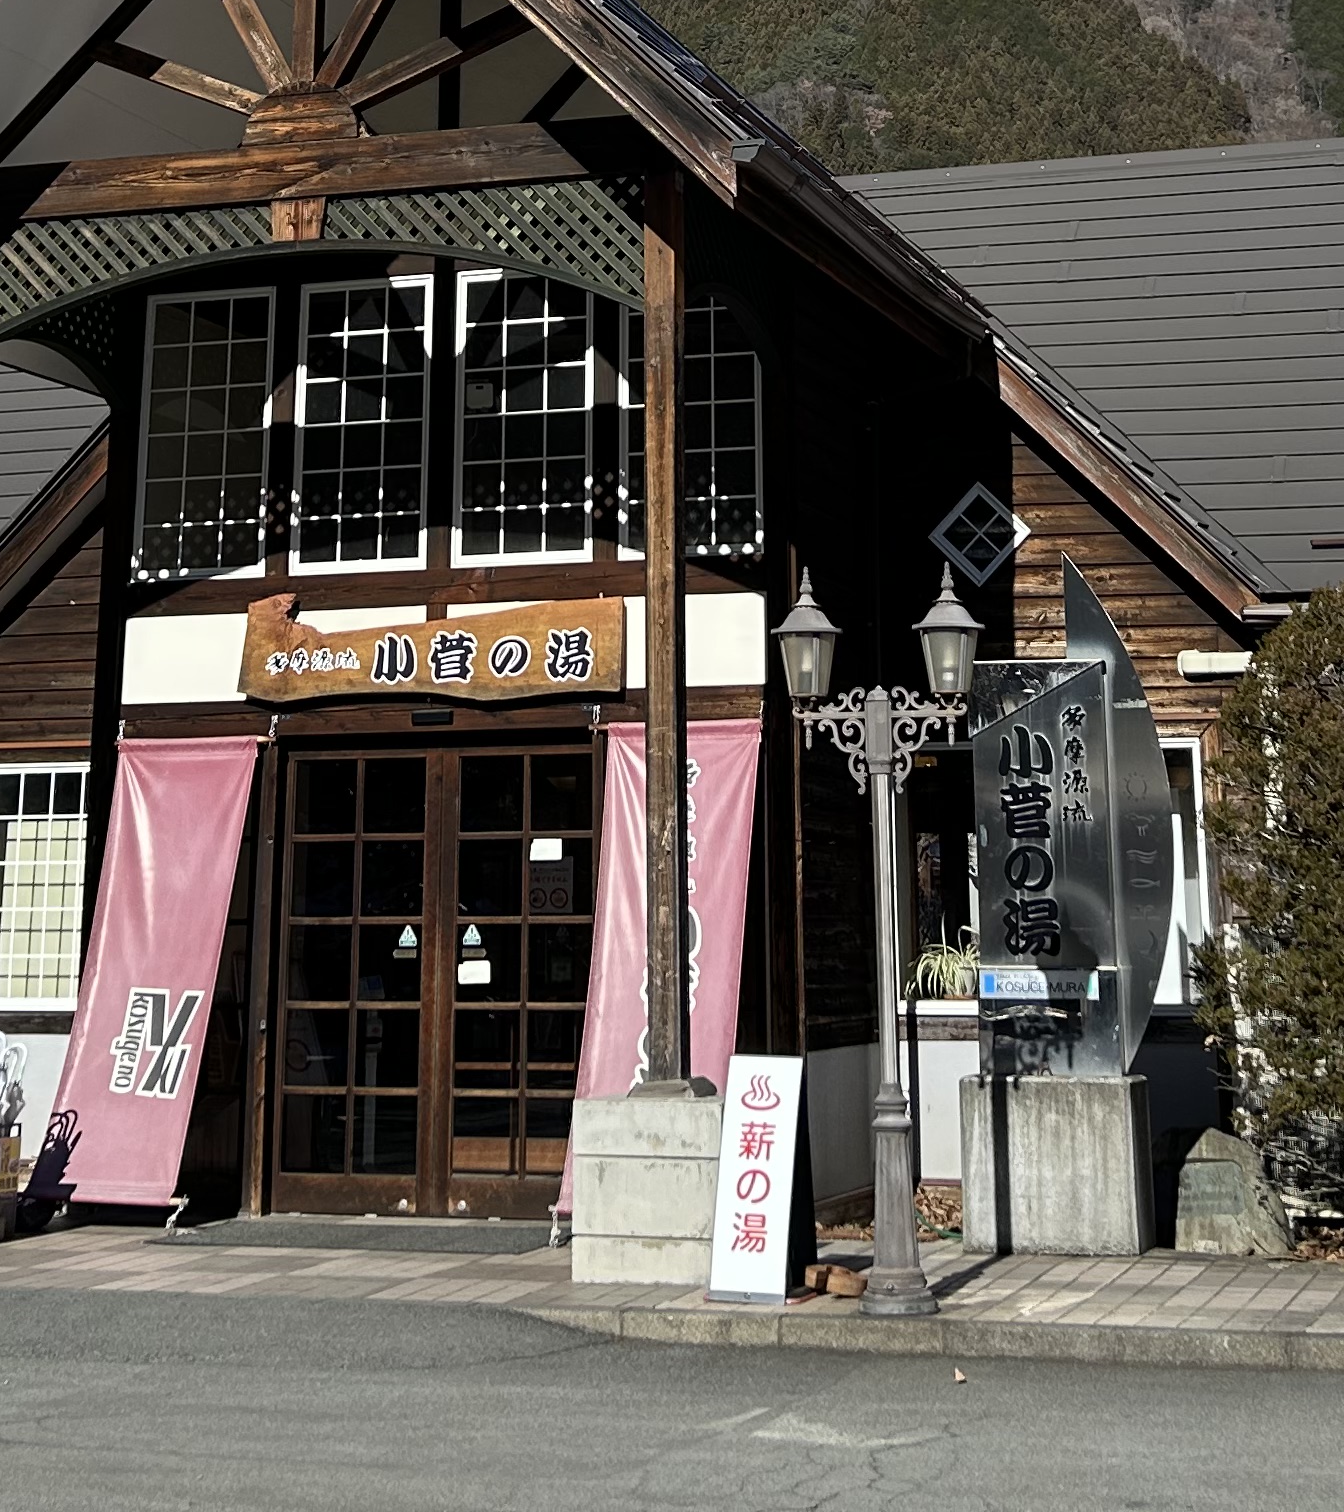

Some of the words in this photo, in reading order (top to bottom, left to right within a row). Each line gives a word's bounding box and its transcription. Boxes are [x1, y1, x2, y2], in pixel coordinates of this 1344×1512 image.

[372, 627, 595, 685] 小菅の湯
[1061, 704, 1093, 823] 多摩源流
[998, 724, 1061, 958] 小菅の湯
[731, 1120, 777, 1253] 薪の湯
